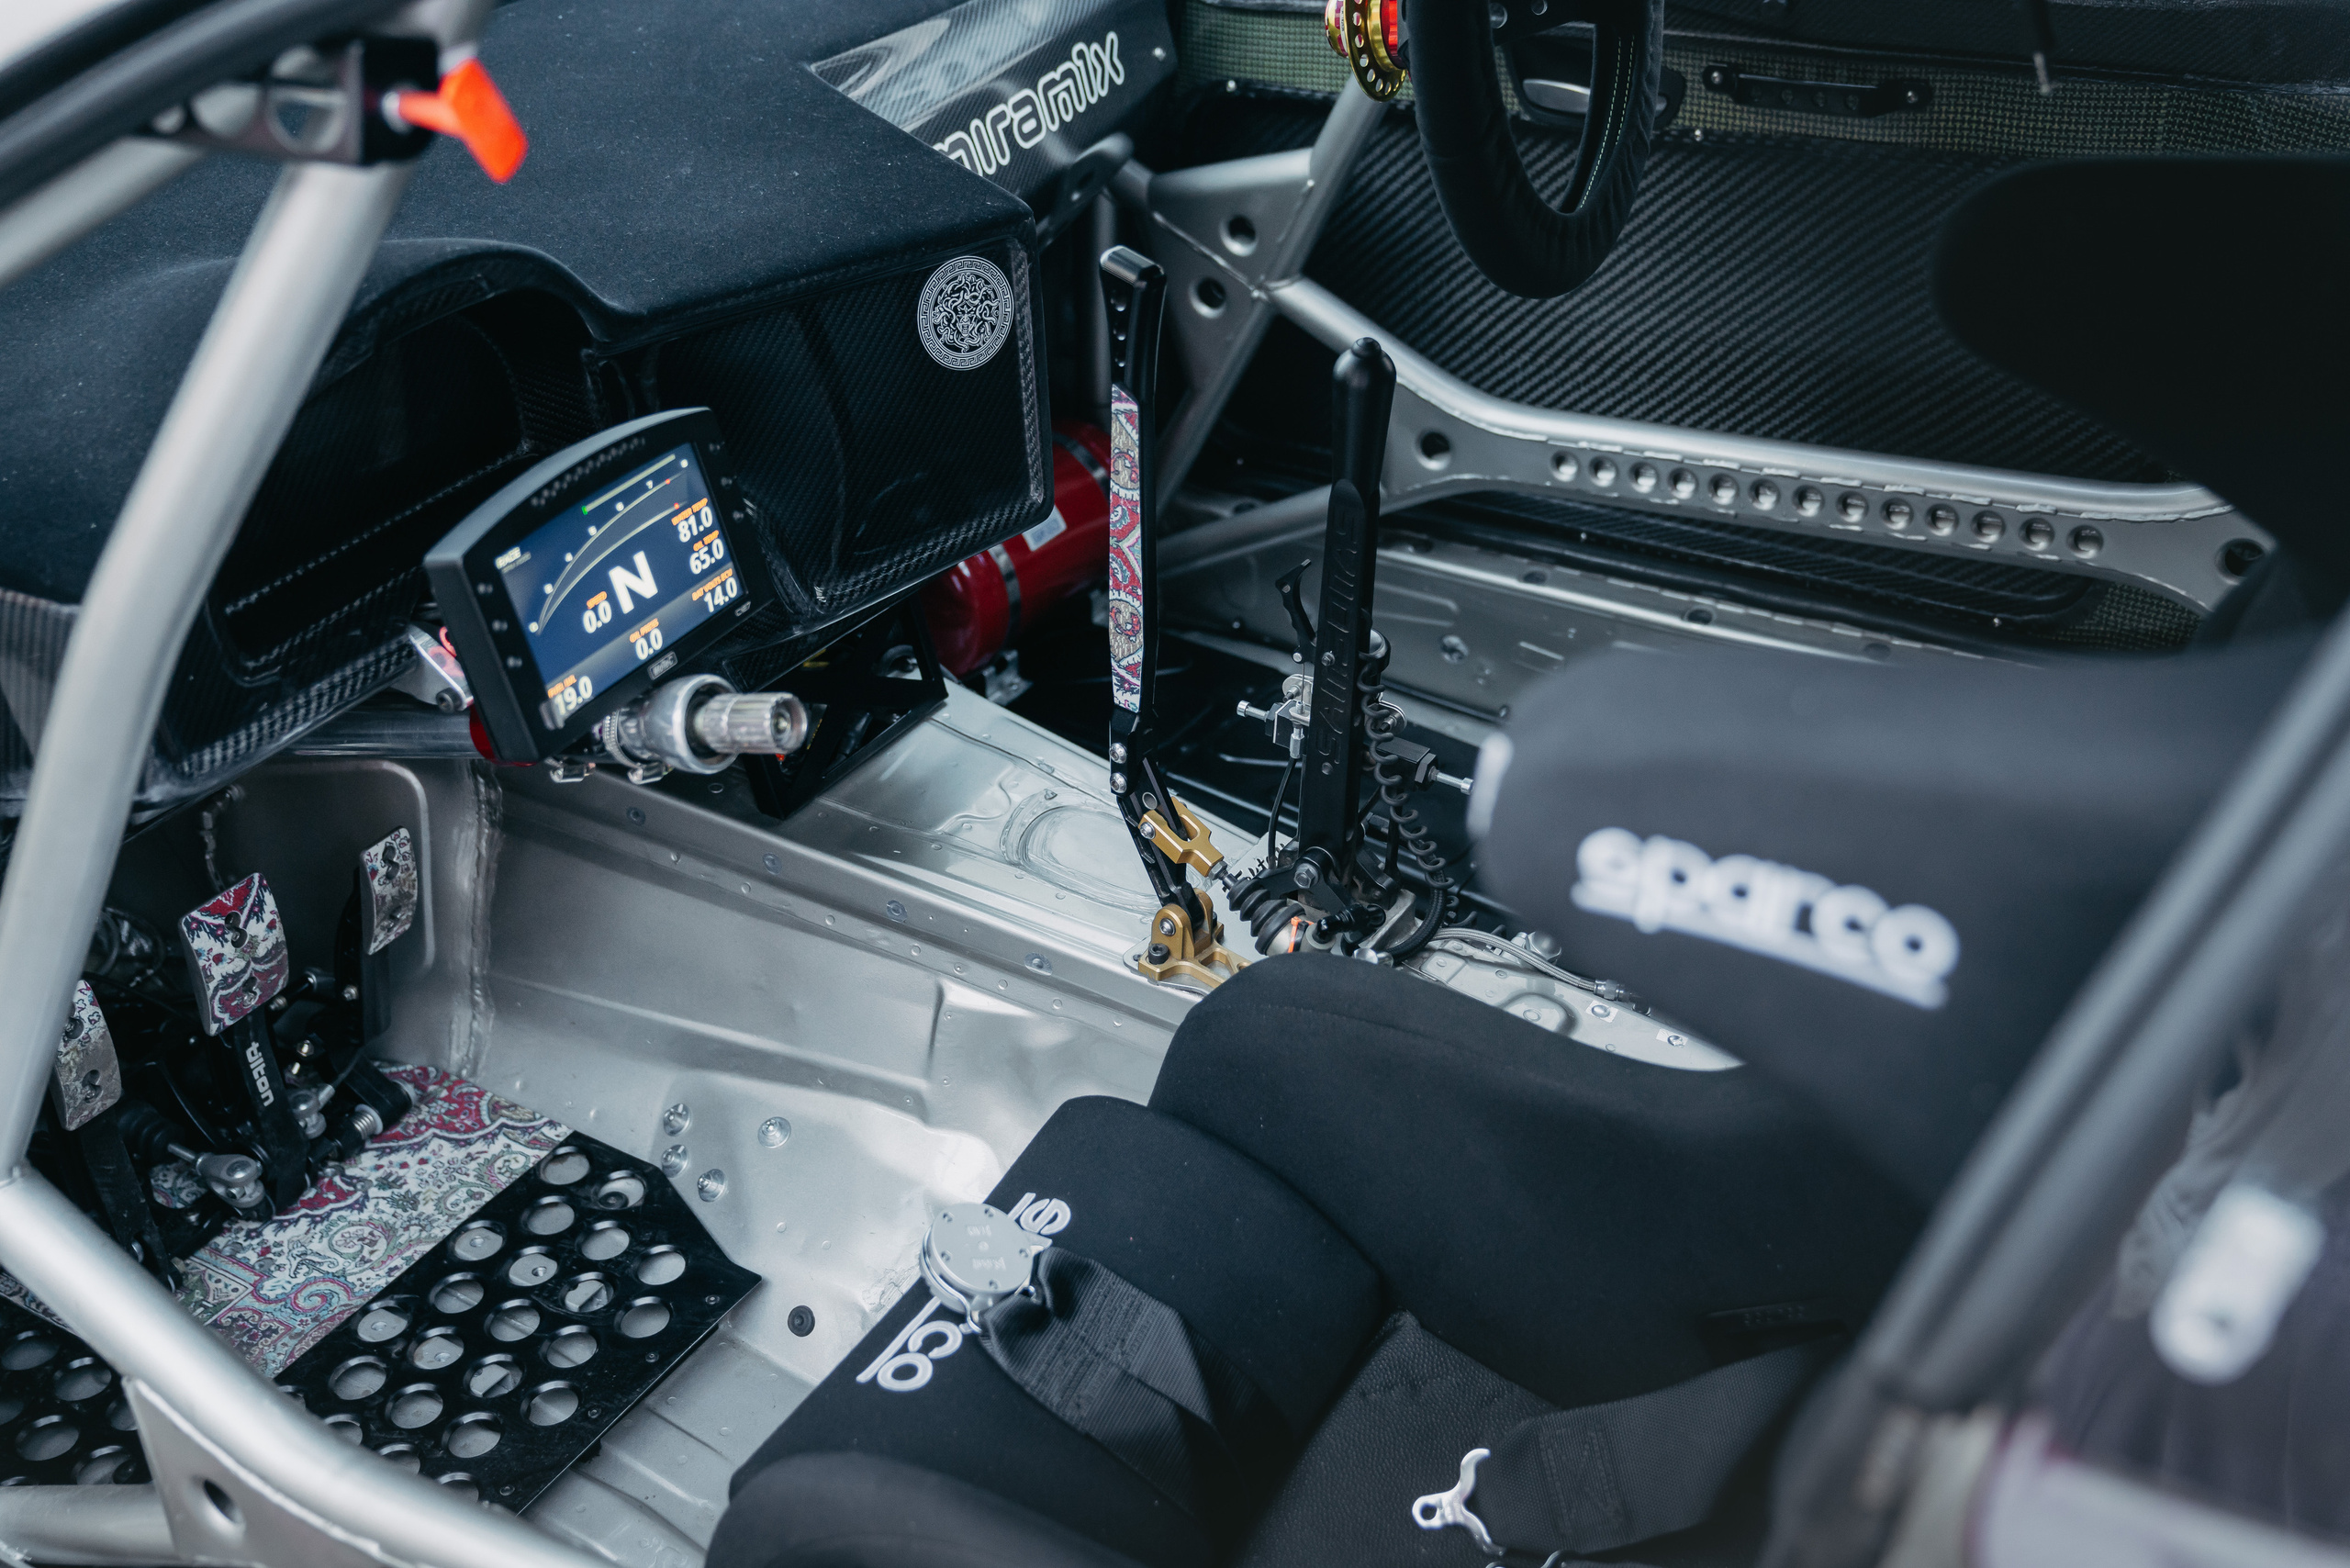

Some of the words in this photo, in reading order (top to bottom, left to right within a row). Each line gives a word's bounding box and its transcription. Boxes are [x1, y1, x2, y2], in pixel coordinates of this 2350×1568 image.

[691, 497, 709, 513] TEMP
[677, 506, 713, 543] 81.0
[703, 530, 720, 545] TEMP
[689, 538, 724, 575] 65.0
[608, 550, 658, 615] N
[704, 577, 738, 613] 14.0
[582, 599, 612, 634] 0.0
[635, 628, 663, 660] 0.0
[554, 675, 593, 716] 19.0
[1572, 826, 1961, 993] sparco
[246, 1041, 274, 1107] tilton
[870, 1196, 1072, 1393] sco
